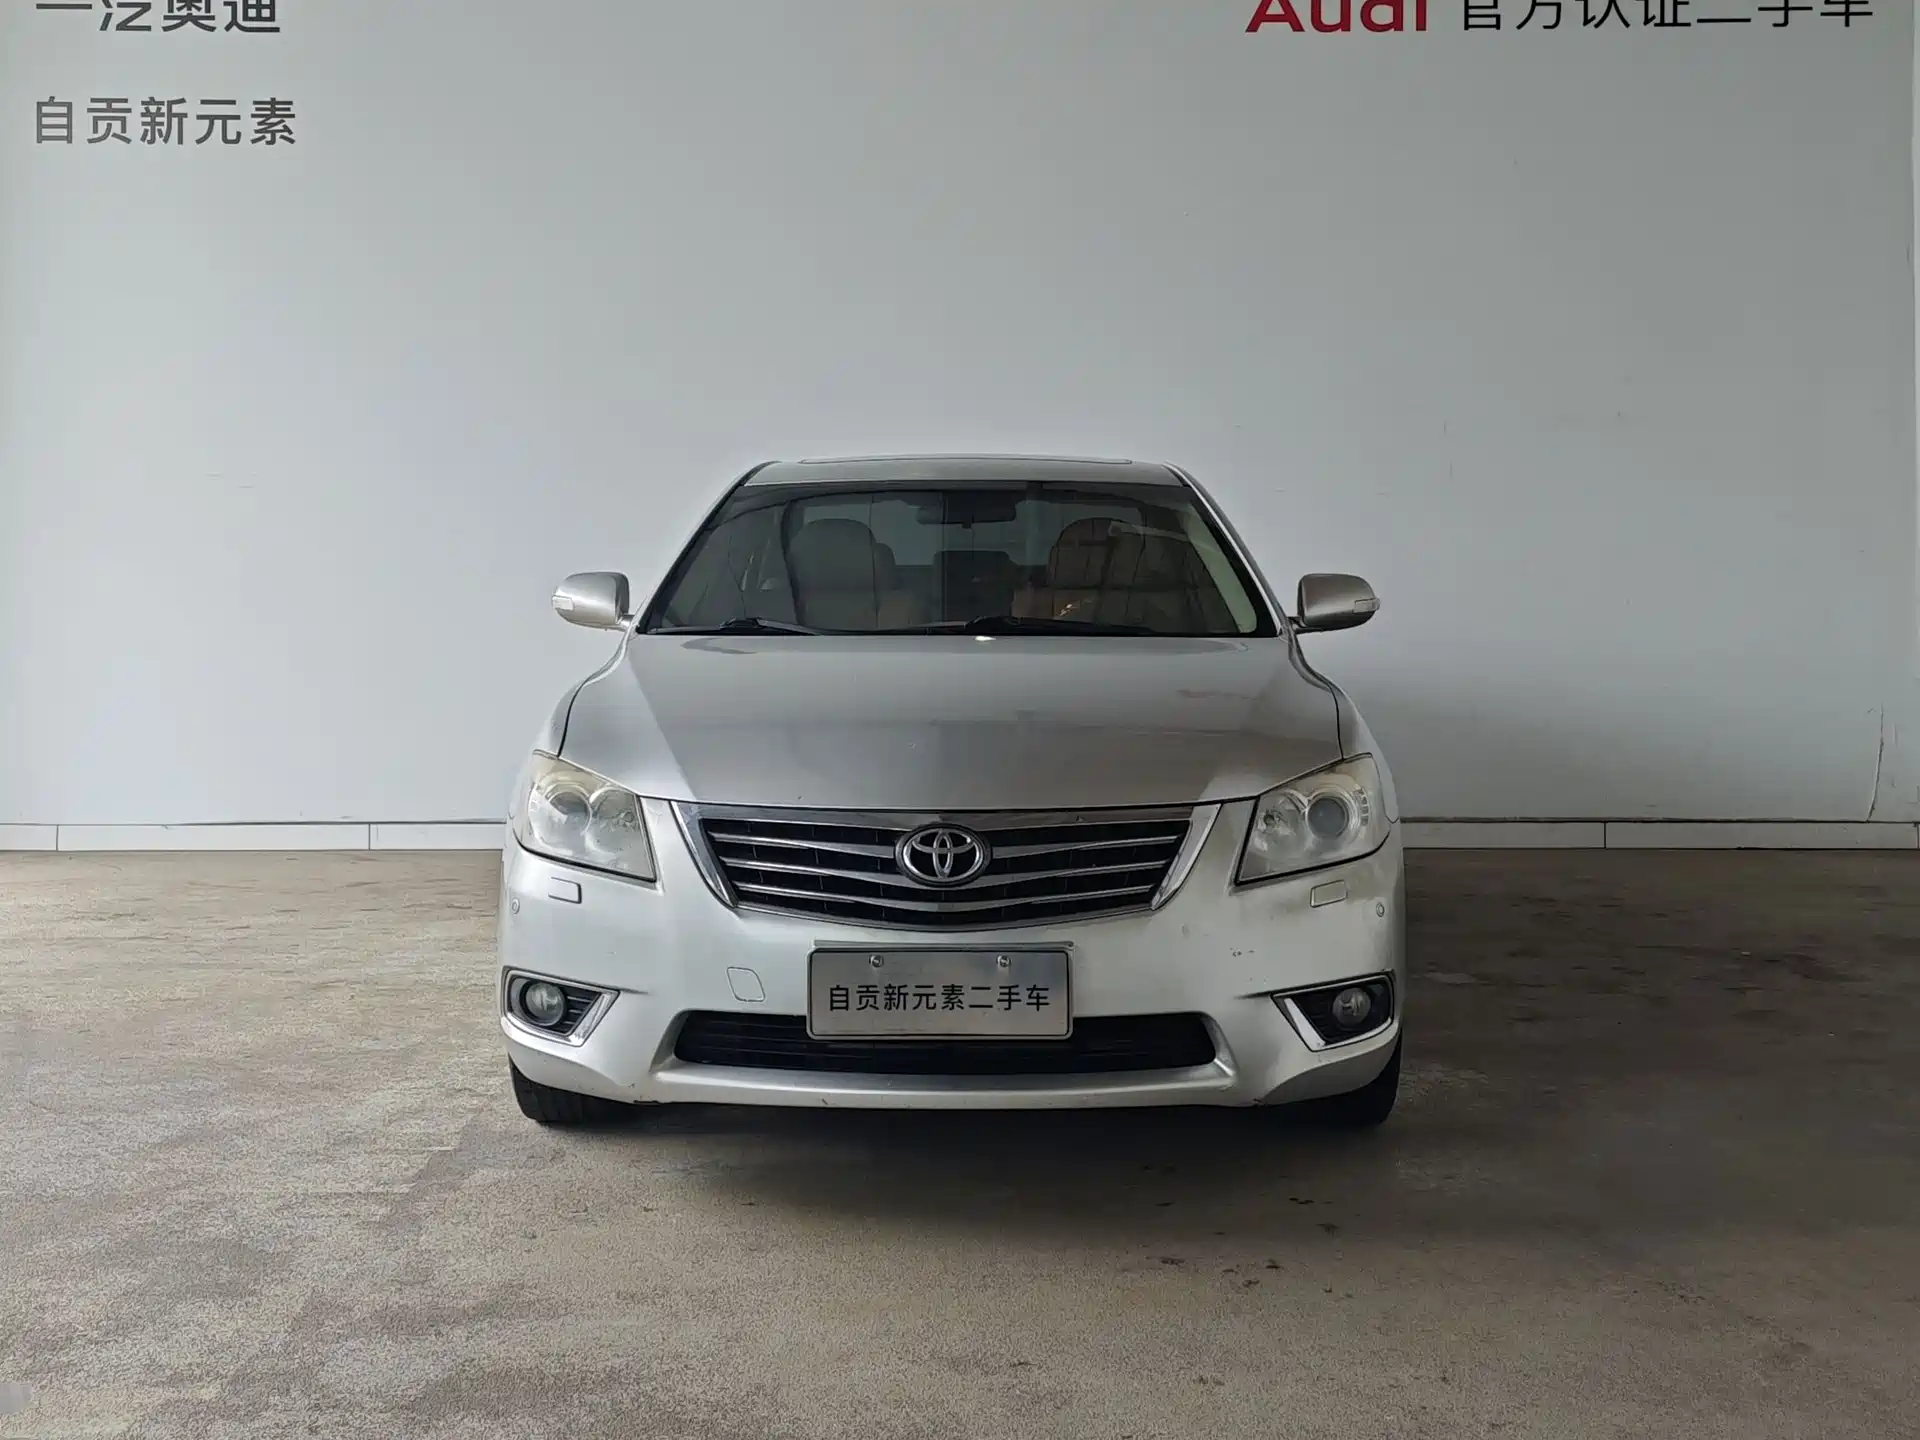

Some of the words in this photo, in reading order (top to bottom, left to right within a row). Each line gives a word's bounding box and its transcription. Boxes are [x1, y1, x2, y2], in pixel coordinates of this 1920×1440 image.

[1245, 0, 1428, 33] Audi
[35, 96, 296, 146] 自贡新元素
[829, 983, 1051, 1012] 自贡新元素二手车
